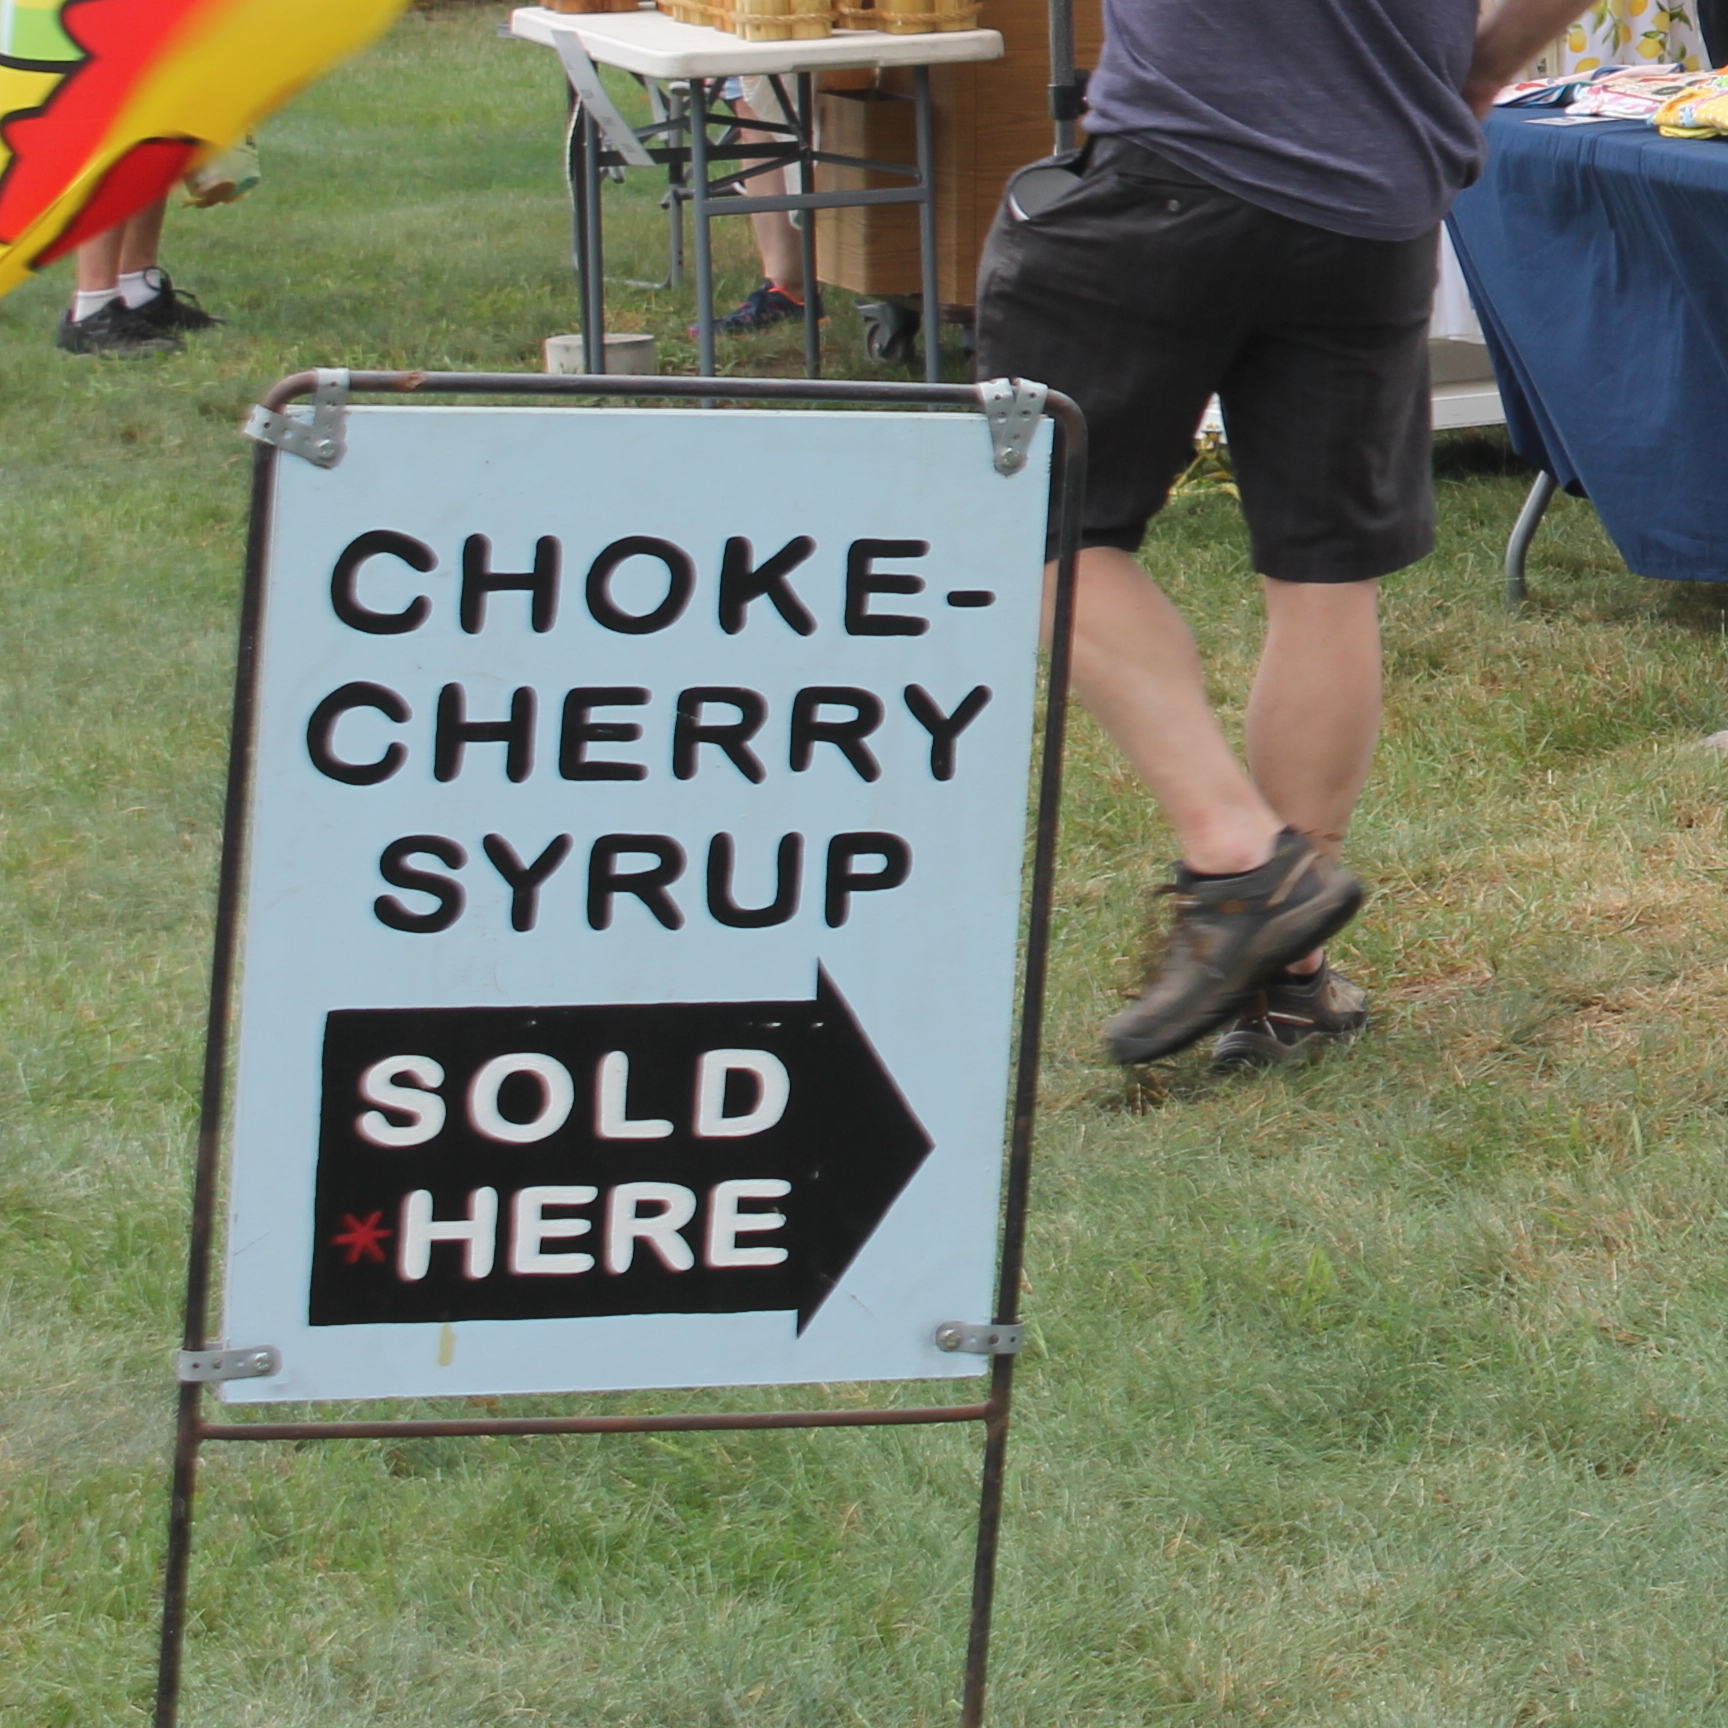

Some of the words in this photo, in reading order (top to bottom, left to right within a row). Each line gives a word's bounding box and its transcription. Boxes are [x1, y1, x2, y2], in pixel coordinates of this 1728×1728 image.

[330, 529, 997, 636] CHOKE-
[306, 681, 993, 786] CHERRY
[372, 830, 913, 934] SYRUP
[356, 1047, 793, 1148] SOLD
[400, 1177, 794, 1282] HERE
